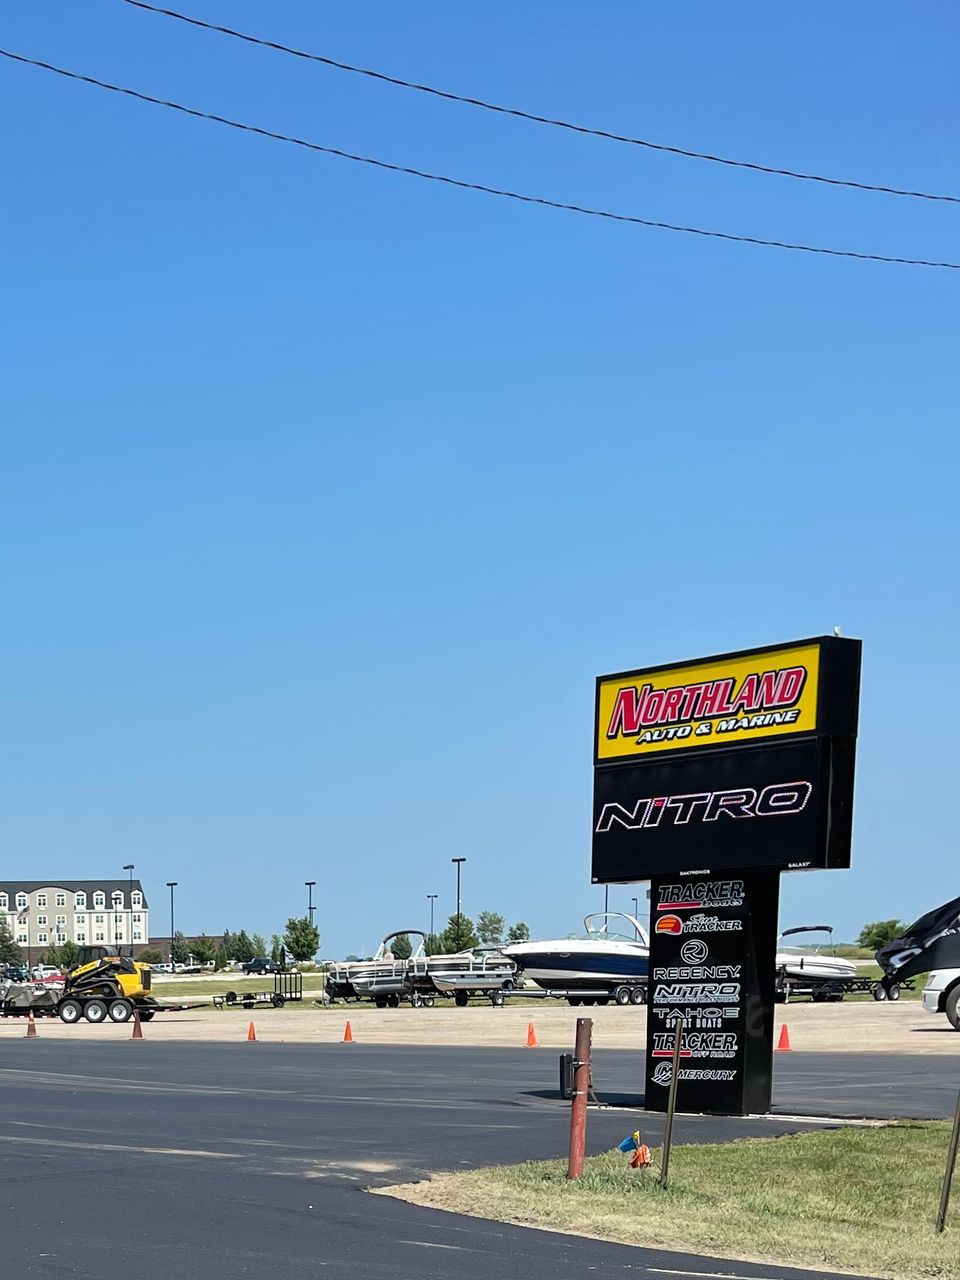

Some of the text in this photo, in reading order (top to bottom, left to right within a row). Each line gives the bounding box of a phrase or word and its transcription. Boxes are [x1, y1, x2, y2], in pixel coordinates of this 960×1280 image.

[607, 666, 805, 736] NORTHLAND
[639, 710, 799, 744] AUTO & MARINE
[595, 781, 812, 832] NITRO
[659, 880, 744, 903] TRACKER
[683, 920, 742, 933] TRACKER
[653, 965, 741, 980] REGENCY
[655, 983, 741, 998] NITRO
[653, 1007, 740, 1018] TAHOE
[665, 1018, 722, 1028] SPRT BOATS
[692, 1050, 709, 1058] OFF
[676, 1069, 737, 1080] MERCURY
